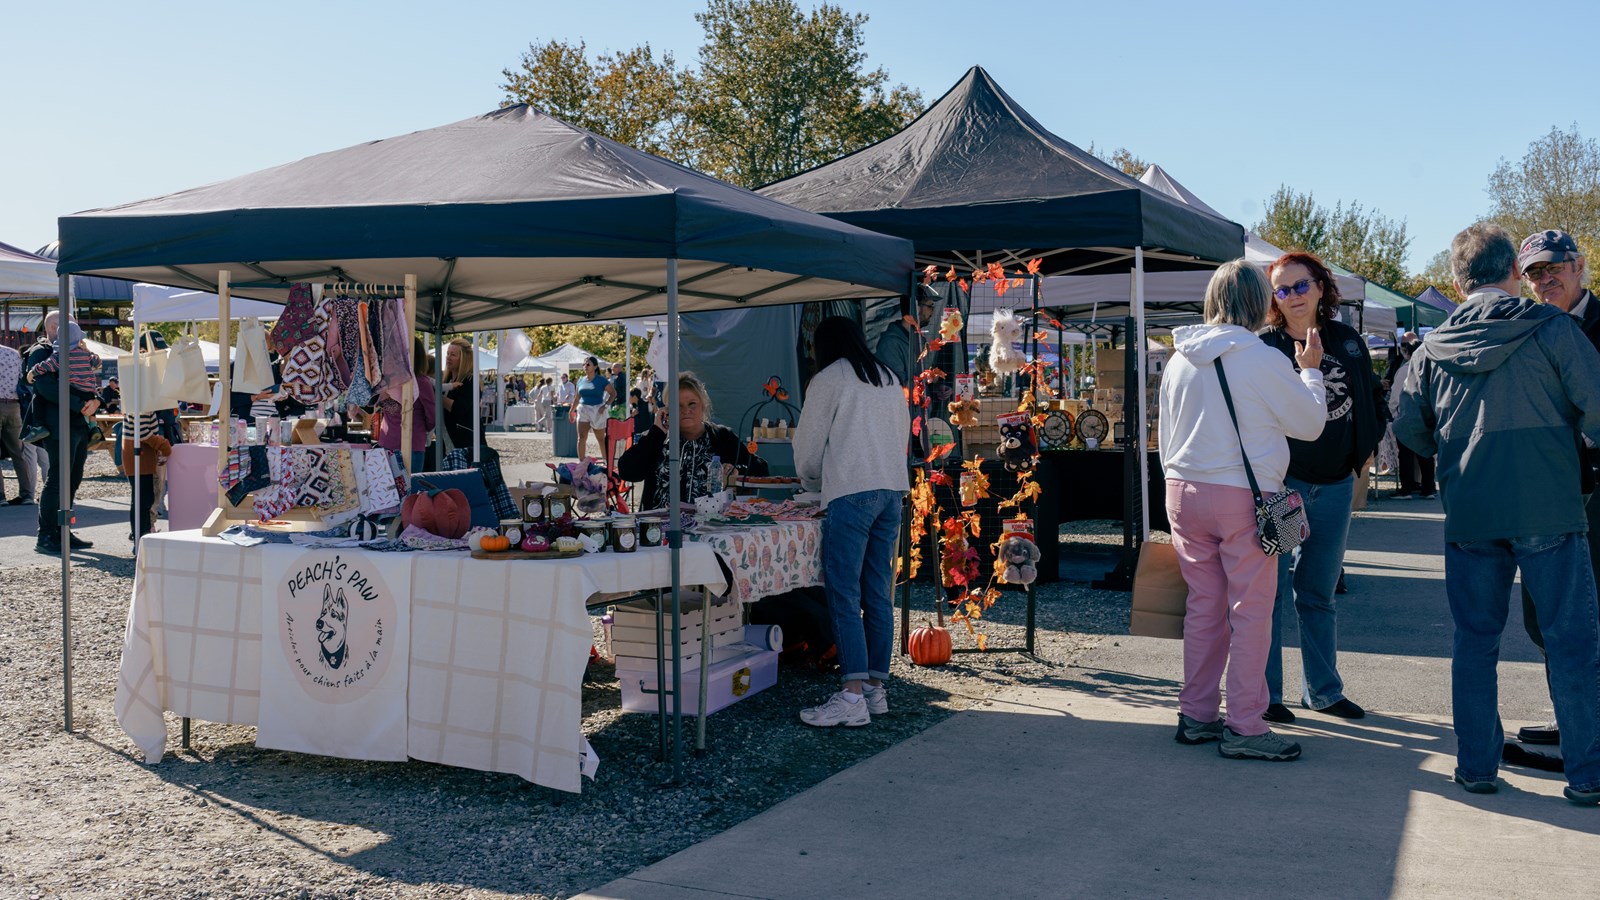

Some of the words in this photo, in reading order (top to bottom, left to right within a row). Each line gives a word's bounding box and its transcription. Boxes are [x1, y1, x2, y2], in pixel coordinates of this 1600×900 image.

[288, 555, 347, 598] PEACH'S
[347, 570, 379, 601] PAW
[295, 658, 312, 677] pour
[313, 675, 341, 688] chiens
[343, 669, 366, 688] faits
[366, 660, 373, 670] à
[370, 650, 378, 662] la
[375, 619, 383, 647] main
